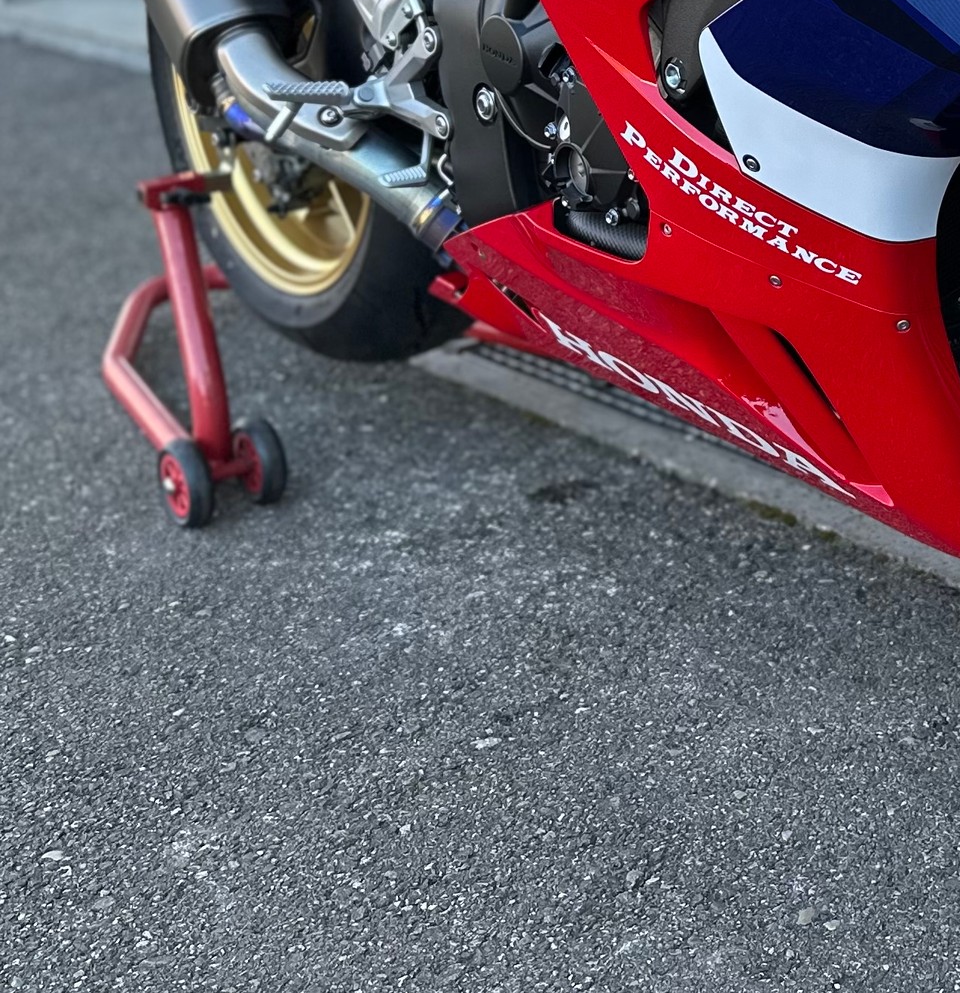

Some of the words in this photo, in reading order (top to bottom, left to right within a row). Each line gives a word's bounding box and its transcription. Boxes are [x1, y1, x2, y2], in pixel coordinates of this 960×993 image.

[620, 120, 863, 285] PERFORMANCE
[668, 146, 798, 238] DIRECT
[539, 310, 856, 500] HONDA
